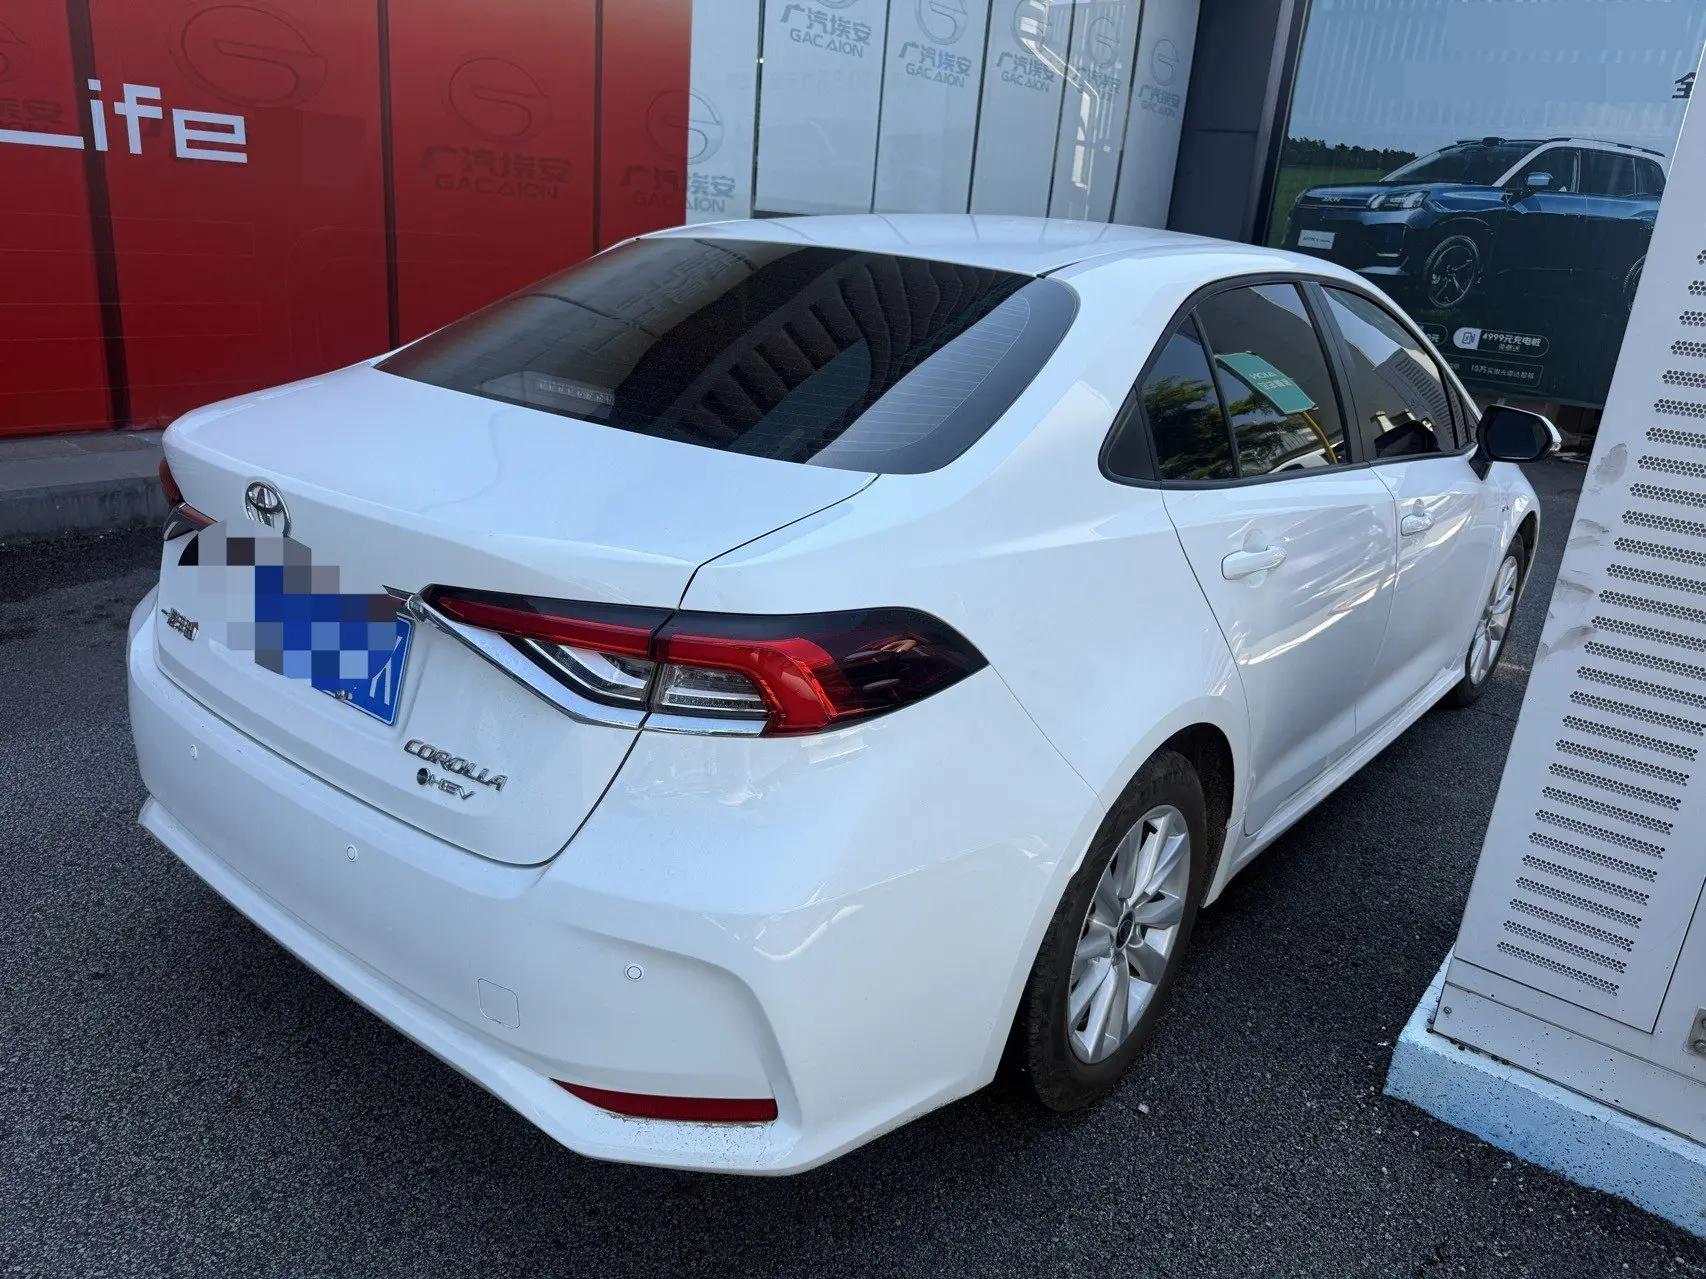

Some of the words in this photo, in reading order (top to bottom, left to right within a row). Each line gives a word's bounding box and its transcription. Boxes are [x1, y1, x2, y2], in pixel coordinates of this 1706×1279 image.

[780, 3, 872, 46] 广汽埃安
[789, 28, 824, 49] GAC
[826, 39, 865, 58] AION
[897, 41, 972, 77] 广汽埃安
[905, 62, 932, 80] GAC
[933, 71, 965, 88] AION
[417, 144, 571, 183] 广汽埃安
[434, 174, 498, 194] GAC
[499, 181, 559, 200] AION
[403, 738, 508, 792] COROLLA
[430, 772, 477, 800] HEV
